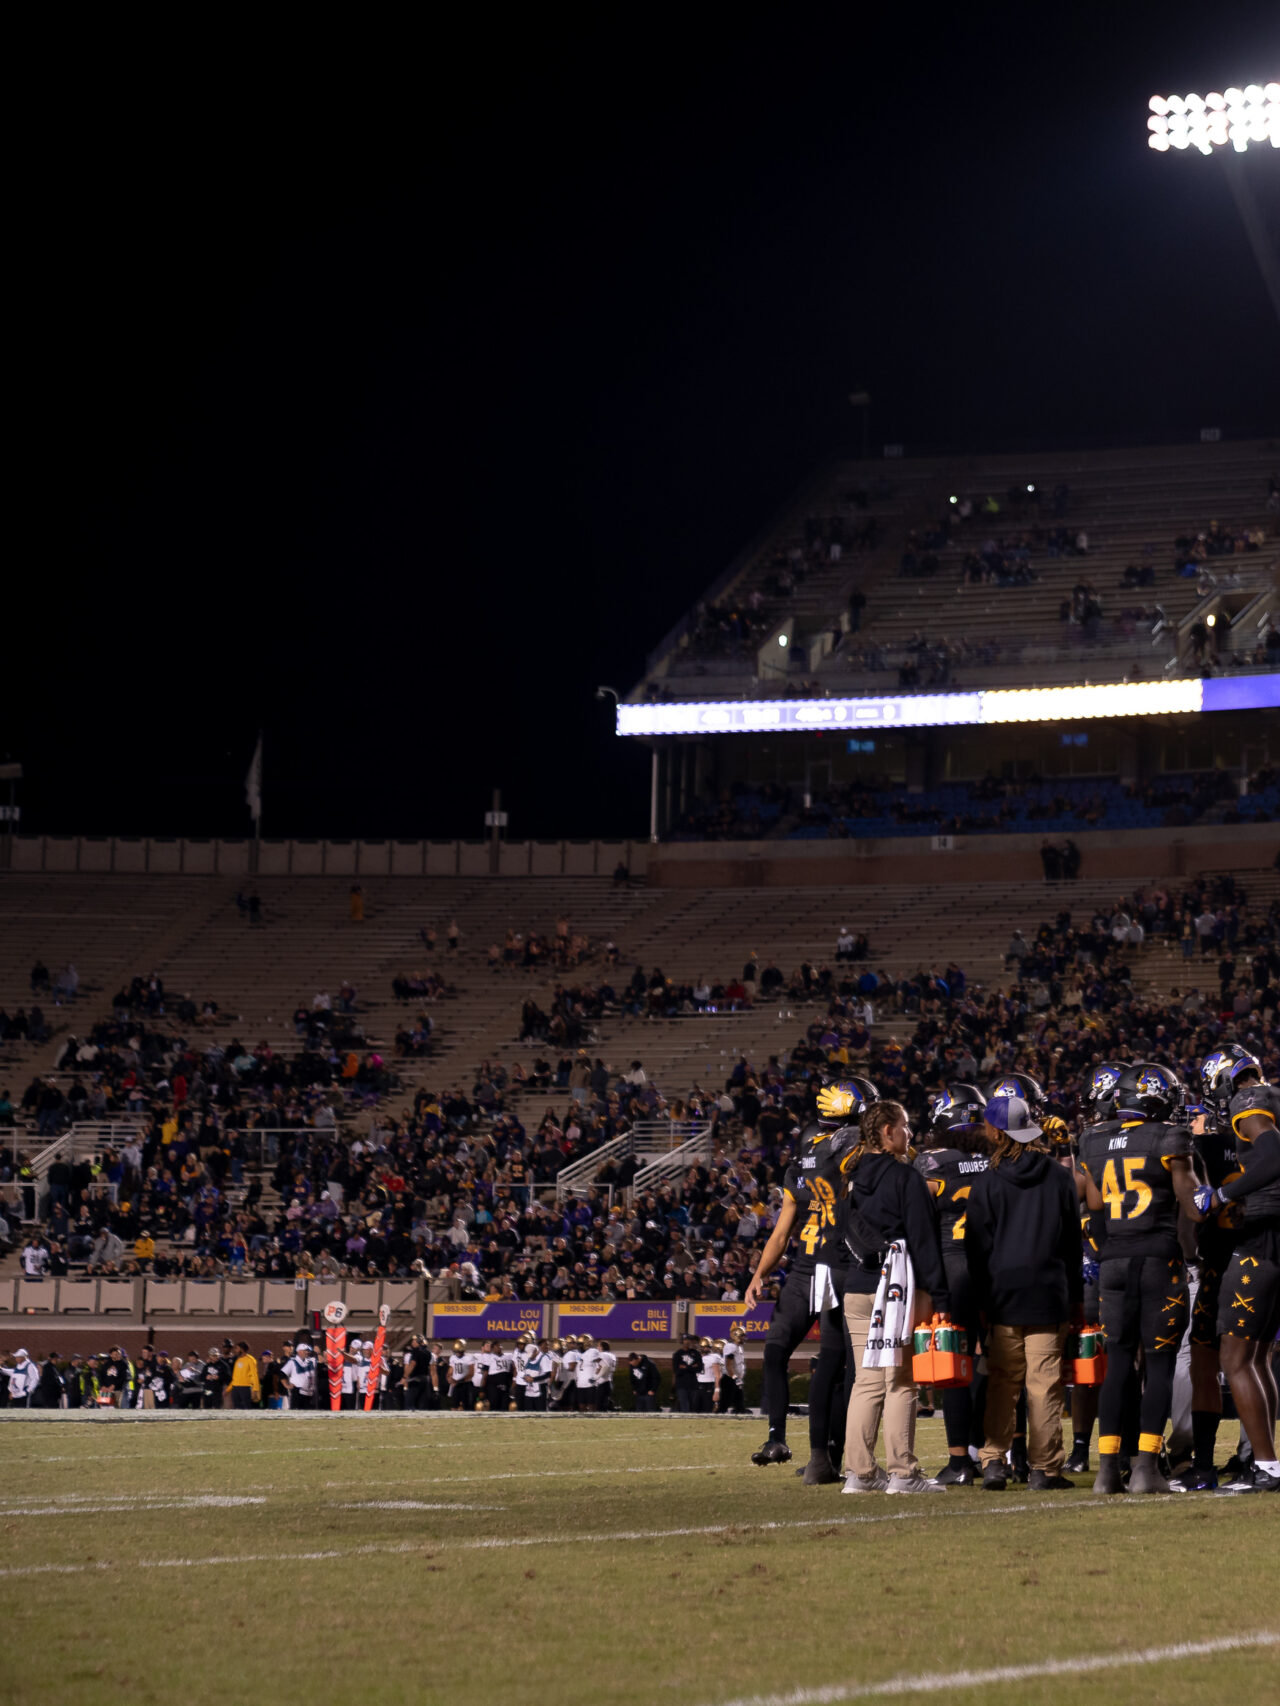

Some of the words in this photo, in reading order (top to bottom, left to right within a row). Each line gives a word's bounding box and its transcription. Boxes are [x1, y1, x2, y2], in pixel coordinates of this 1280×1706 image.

[1108, 1136, 1128, 1150] KING
[1101, 1156, 1152, 1220] 45
[520, 1310, 539, 1319] LOU
[647, 1310, 667, 1319] BILL
[487, 1320, 539, 1331] HALLOW
[631, 1320, 668, 1331] CLINE
